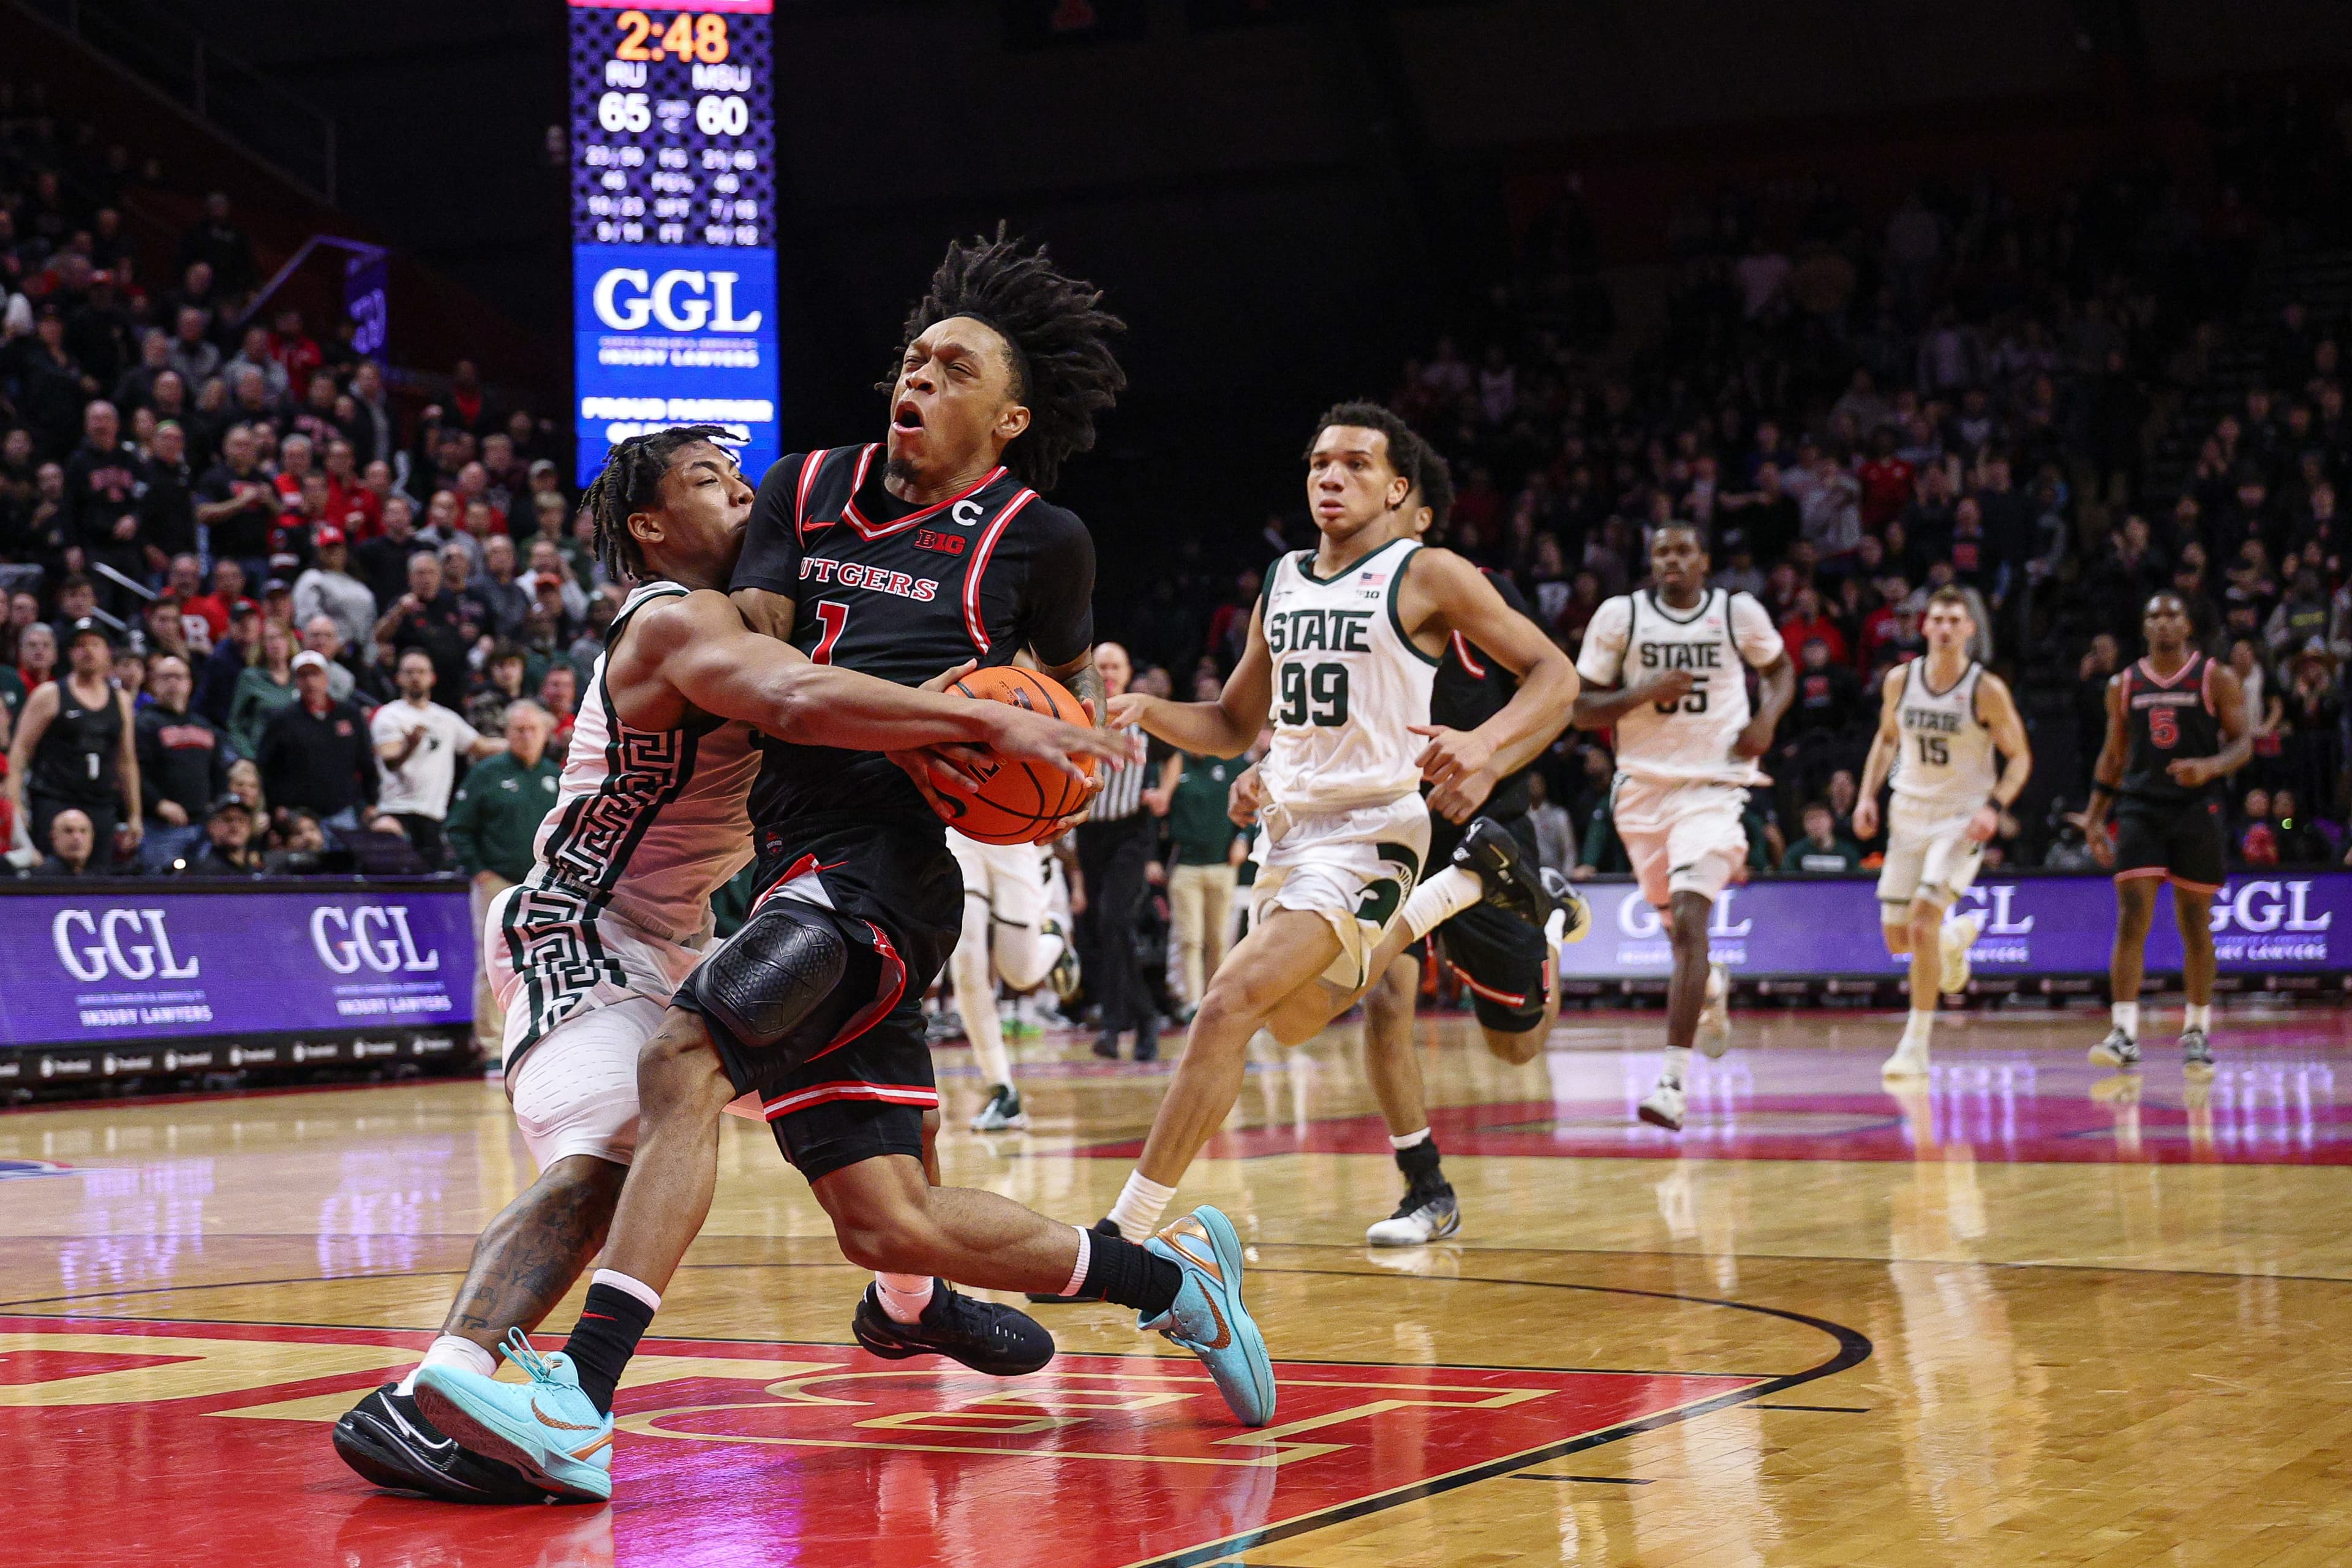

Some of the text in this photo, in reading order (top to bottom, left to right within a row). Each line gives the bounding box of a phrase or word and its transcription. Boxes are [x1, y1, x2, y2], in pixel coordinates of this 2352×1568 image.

[616, 10, 729, 63] 2:48
[605, 60, 751, 91] RU MSU
[598, 91, 650, 132] 65
[696, 94, 748, 135] 60
[593, 268, 763, 332] GGL
[952, 500, 984, 526] C
[799, 557, 939, 601] UTGERS
[810, 600, 850, 666] 1
[1270, 609, 1376, 654] STATE
[1641, 642, 1722, 668] STATE
[1280, 662, 1349, 726] 99
[1656, 676, 1709, 713] 5
[1917, 736, 1948, 765] 15
[2149, 707, 2179, 749] 5
[1618, 889, 1752, 938] GL
[1943, 886, 2034, 934] GL
[52, 909, 200, 981] GGL
[310, 907, 440, 974] GGL
